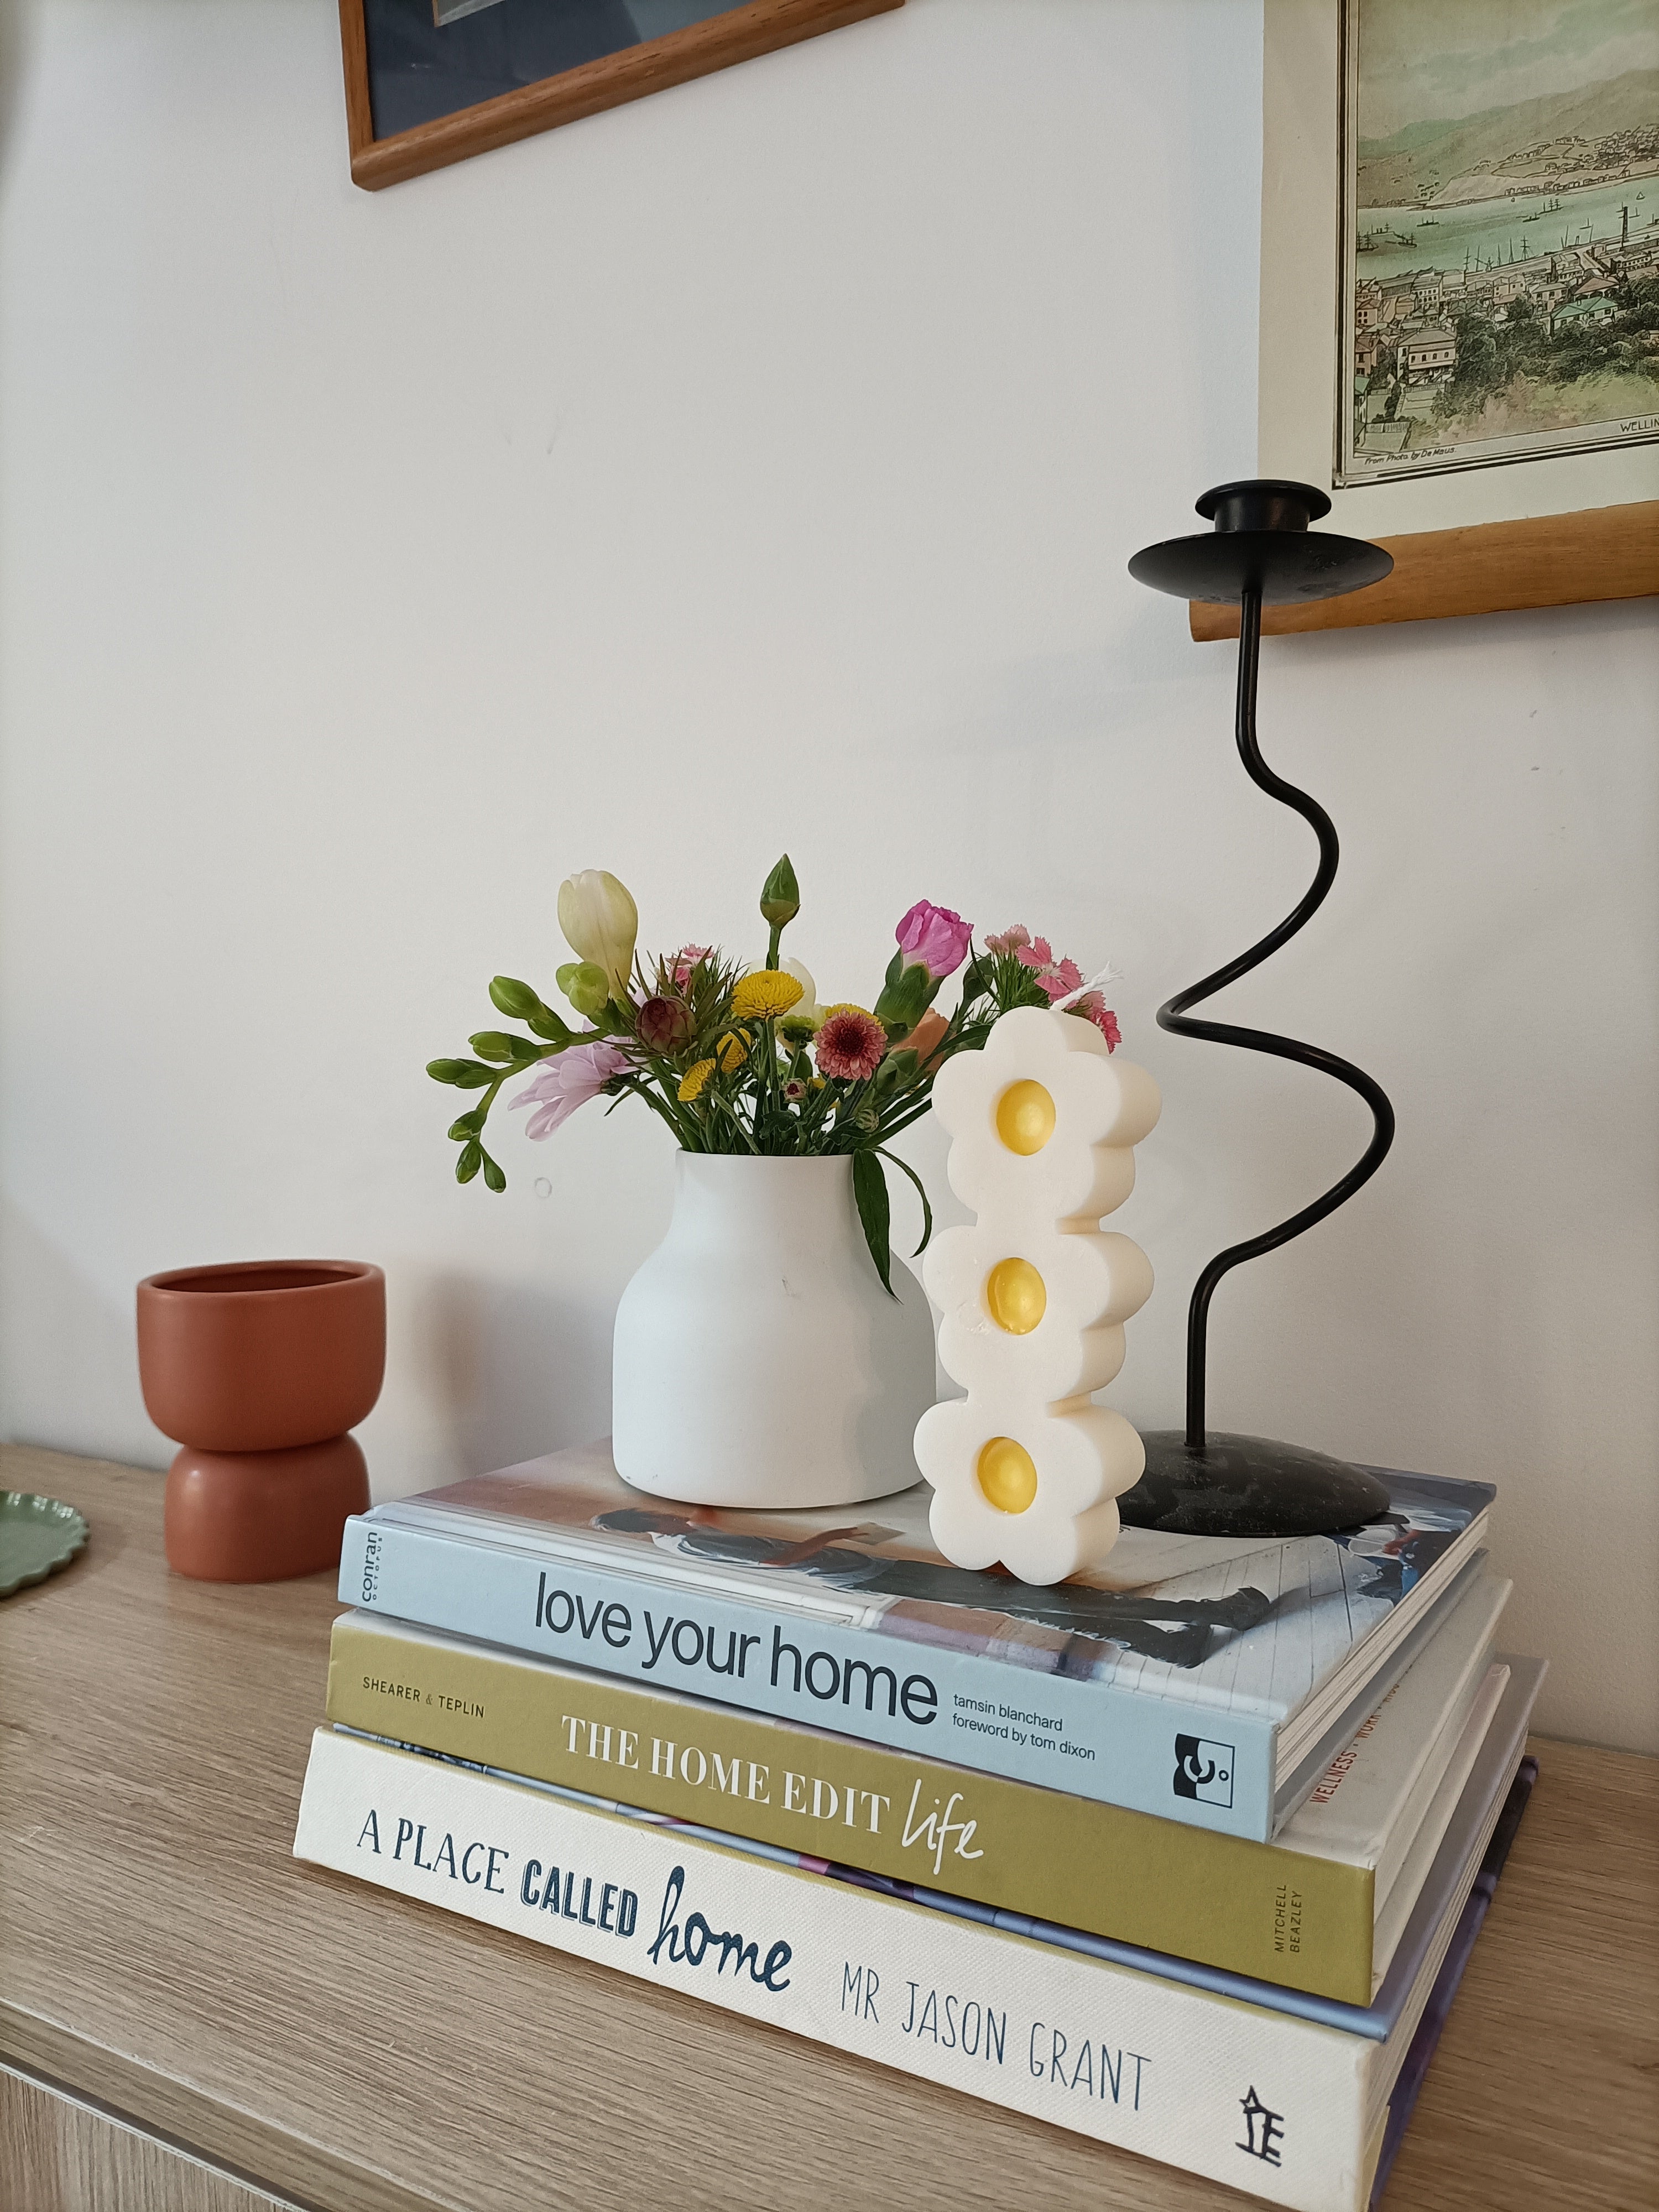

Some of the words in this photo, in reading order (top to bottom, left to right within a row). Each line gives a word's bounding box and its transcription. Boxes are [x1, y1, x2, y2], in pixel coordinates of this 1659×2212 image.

[1386, 452, 1408, 462] Photo
[1411, 451, 1421, 461] by
[362, 1532, 378, 1602] conran
[535, 1571, 632, 1648] love
[641, 1610, 761, 1678] your
[770, 1625, 938, 1725] home
[362, 1676, 420, 1702] SHEARER
[425, 1693, 433, 1705] &
[438, 1694, 484, 1718] TEPLIN
[953, 1693, 995, 1715] tamsin
[999, 1703, 1063, 1731] blanchard
[952, 1713, 1009, 1739] foreword
[1011, 1728, 1027, 1746] by
[1030, 1735, 1056, 1751] tom
[1059, 1740, 1095, 1761] dixon
[561, 1715, 640, 1770] THE
[648, 1737, 770, 1804] HOME
[780, 1770, 890, 1834] EDIT
[901, 1778, 984, 1876] life
[1309, 1751, 1358, 1803] WELLNESS
[357, 1808, 382, 1854] A
[392, 1817, 510, 1894] PLACE
[520, 1859, 638, 1939] CALLED
[646, 1865, 792, 1992] home
[1274, 1885, 1286, 1953] MITCHELL
[1289, 1890, 1302, 1953] BEAZLEY
[841, 1961, 880, 2023] MR
[901, 1981, 1006, 2065] JASON
[1030, 2022, 1152, 2111] GRANT
